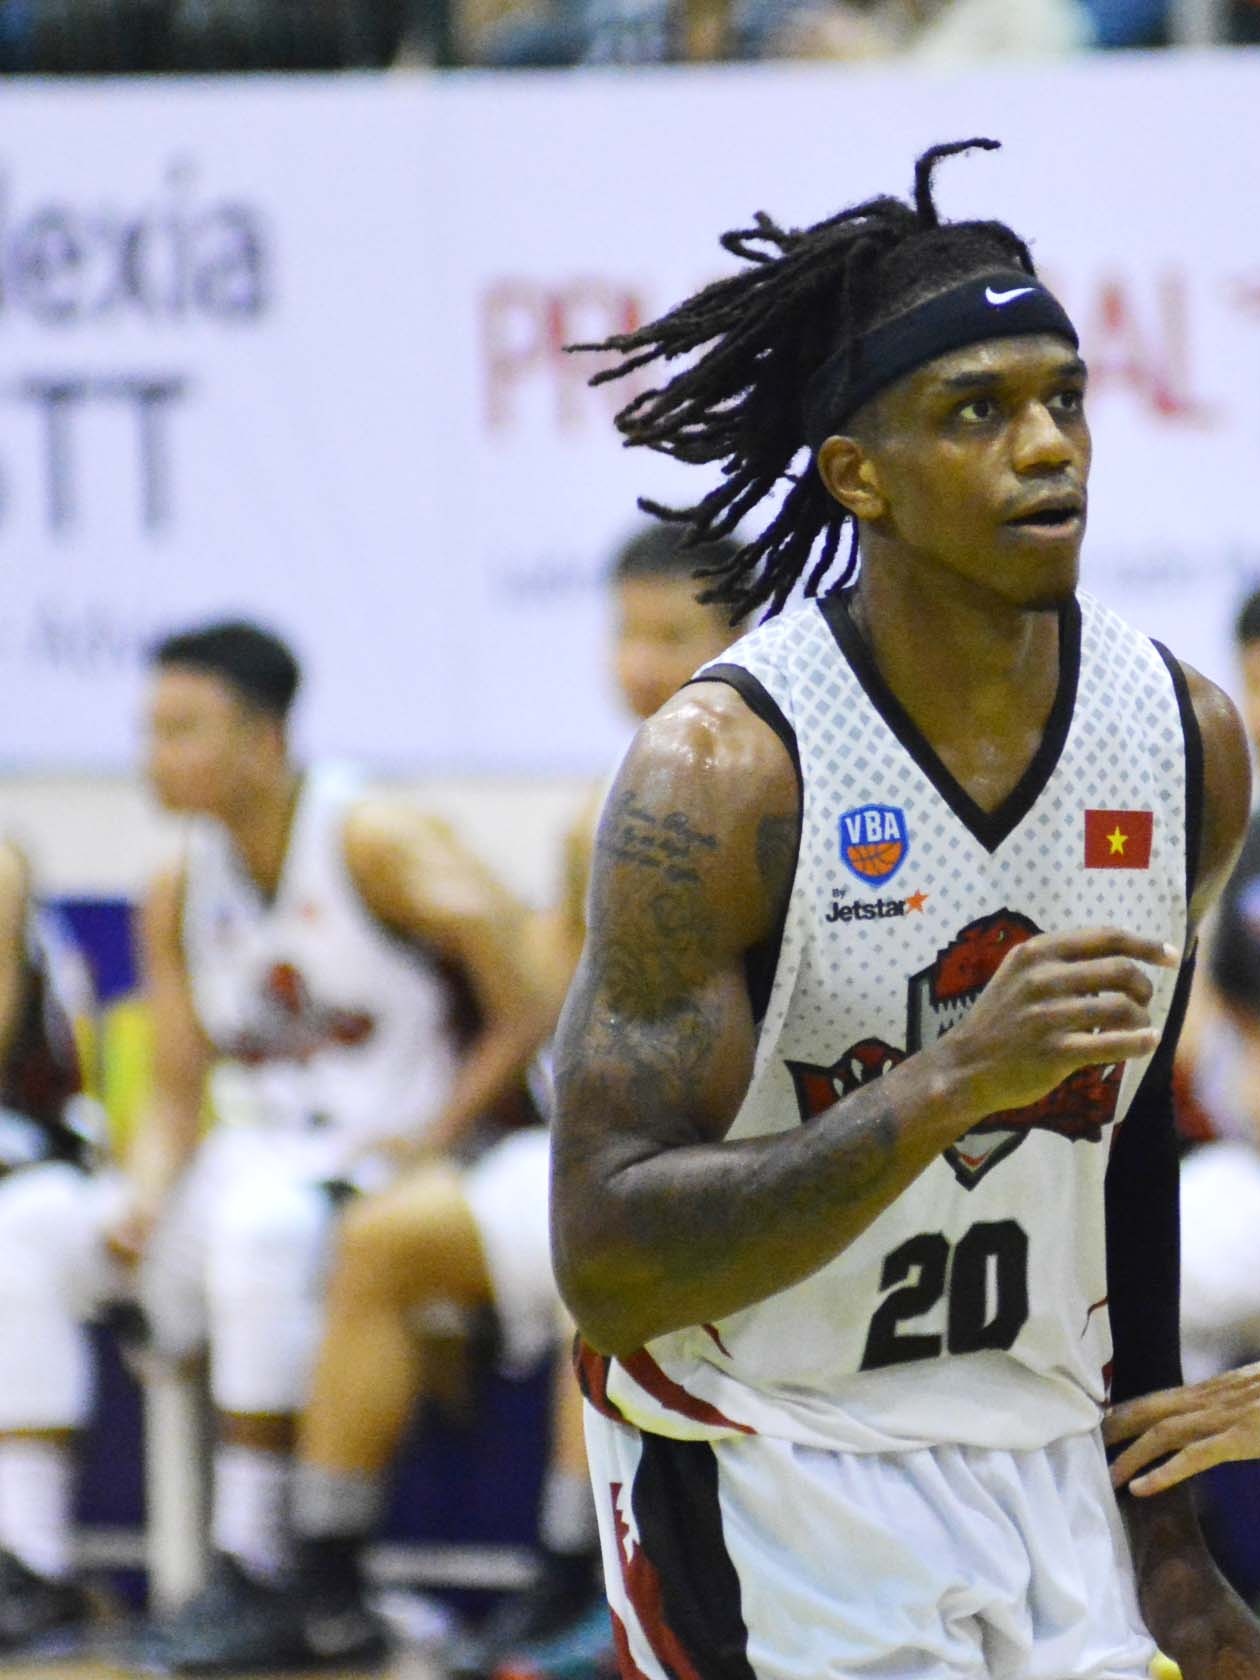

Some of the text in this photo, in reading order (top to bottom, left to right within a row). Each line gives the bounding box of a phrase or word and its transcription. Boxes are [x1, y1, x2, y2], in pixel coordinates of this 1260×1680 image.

[0, 372, 192, 538] TT
[844, 809, 901, 845] VBA
[825, 898, 907, 923] Jetstar
[859, 1217, 1030, 1372] 20
